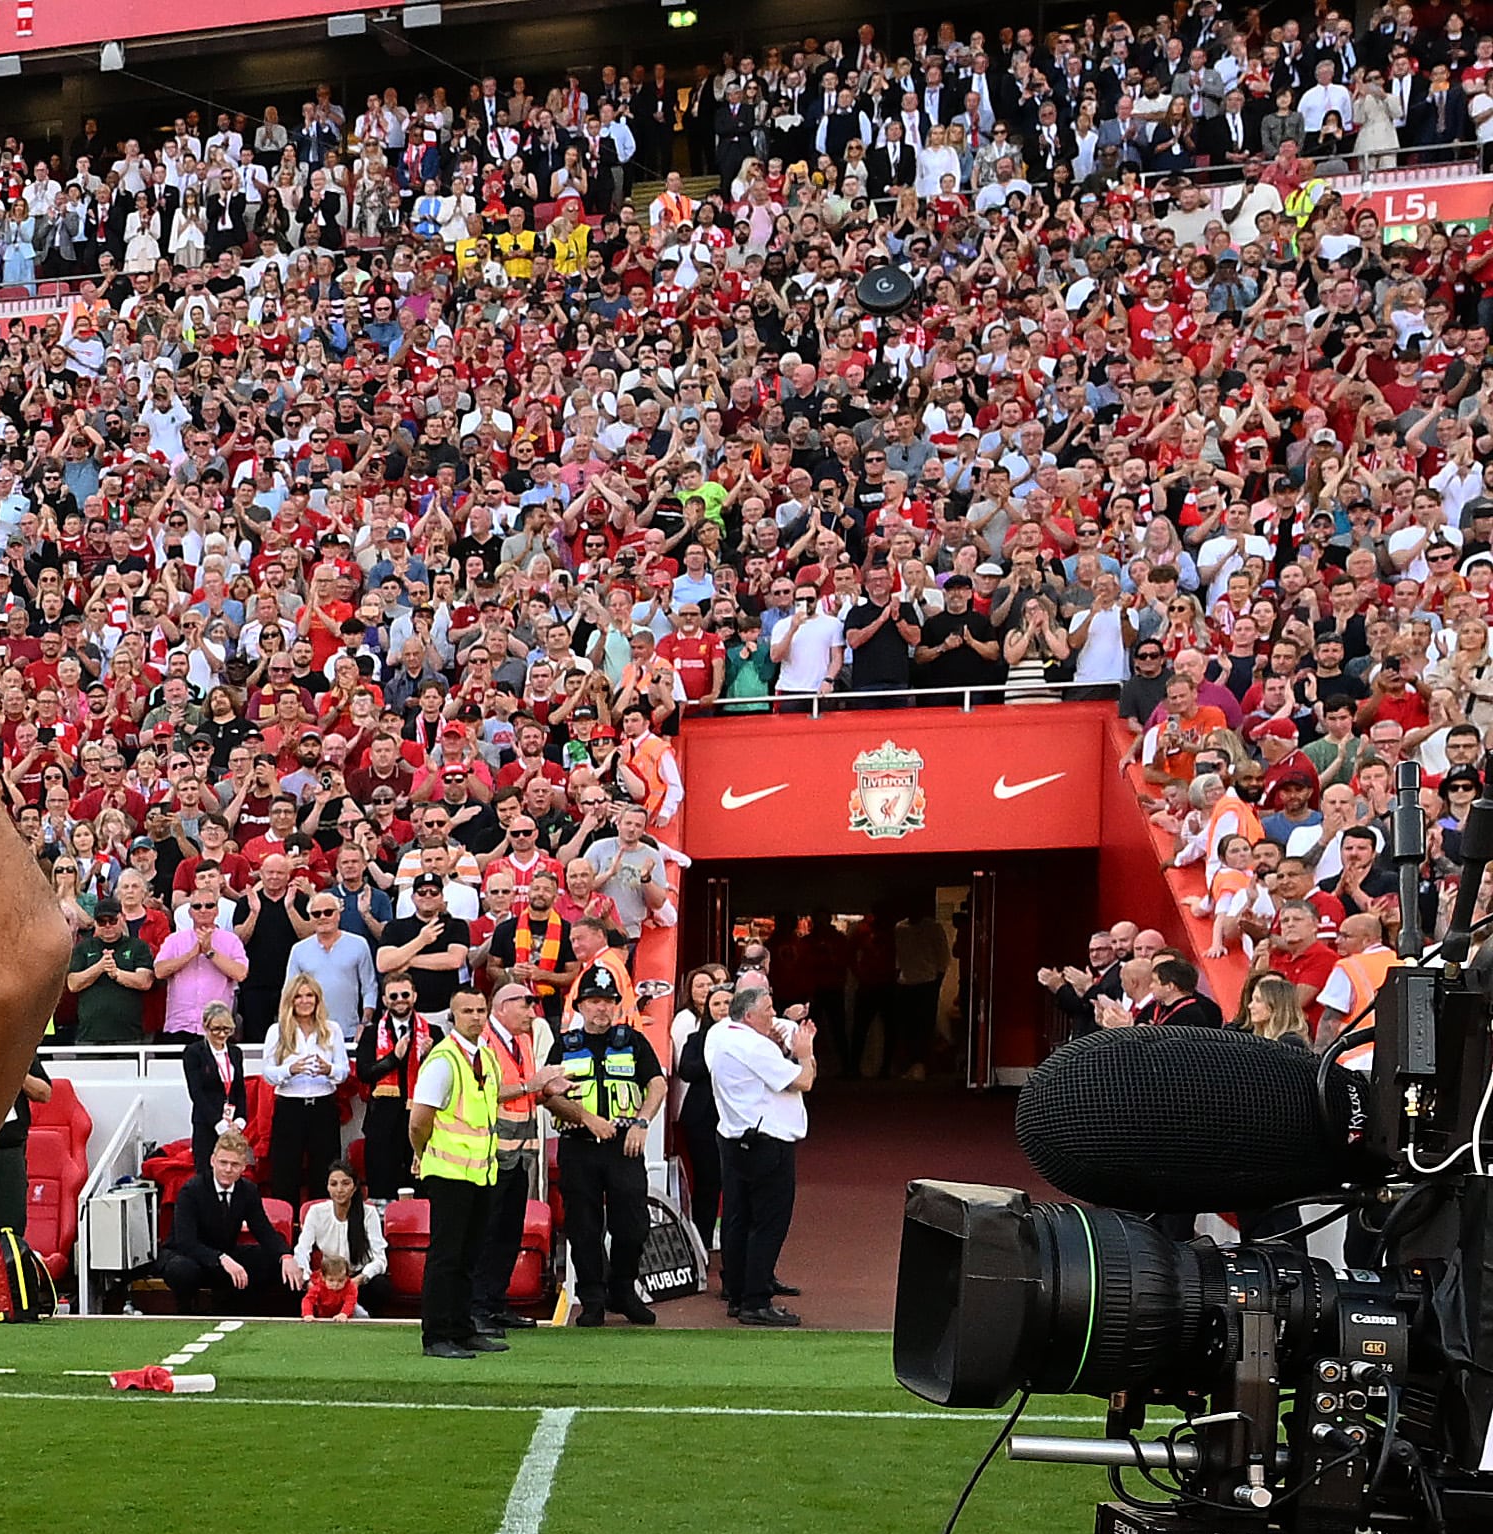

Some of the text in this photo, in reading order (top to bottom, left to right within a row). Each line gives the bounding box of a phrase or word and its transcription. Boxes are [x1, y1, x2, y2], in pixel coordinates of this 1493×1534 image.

[1385, 193, 1426, 222] L5
[863, 777, 911, 787] LIVERPOOL
[645, 1266, 693, 1291] HUBLOT
[1351, 1313, 1397, 1325] Canon
[1365, 1343, 1383, 1353] 4K
